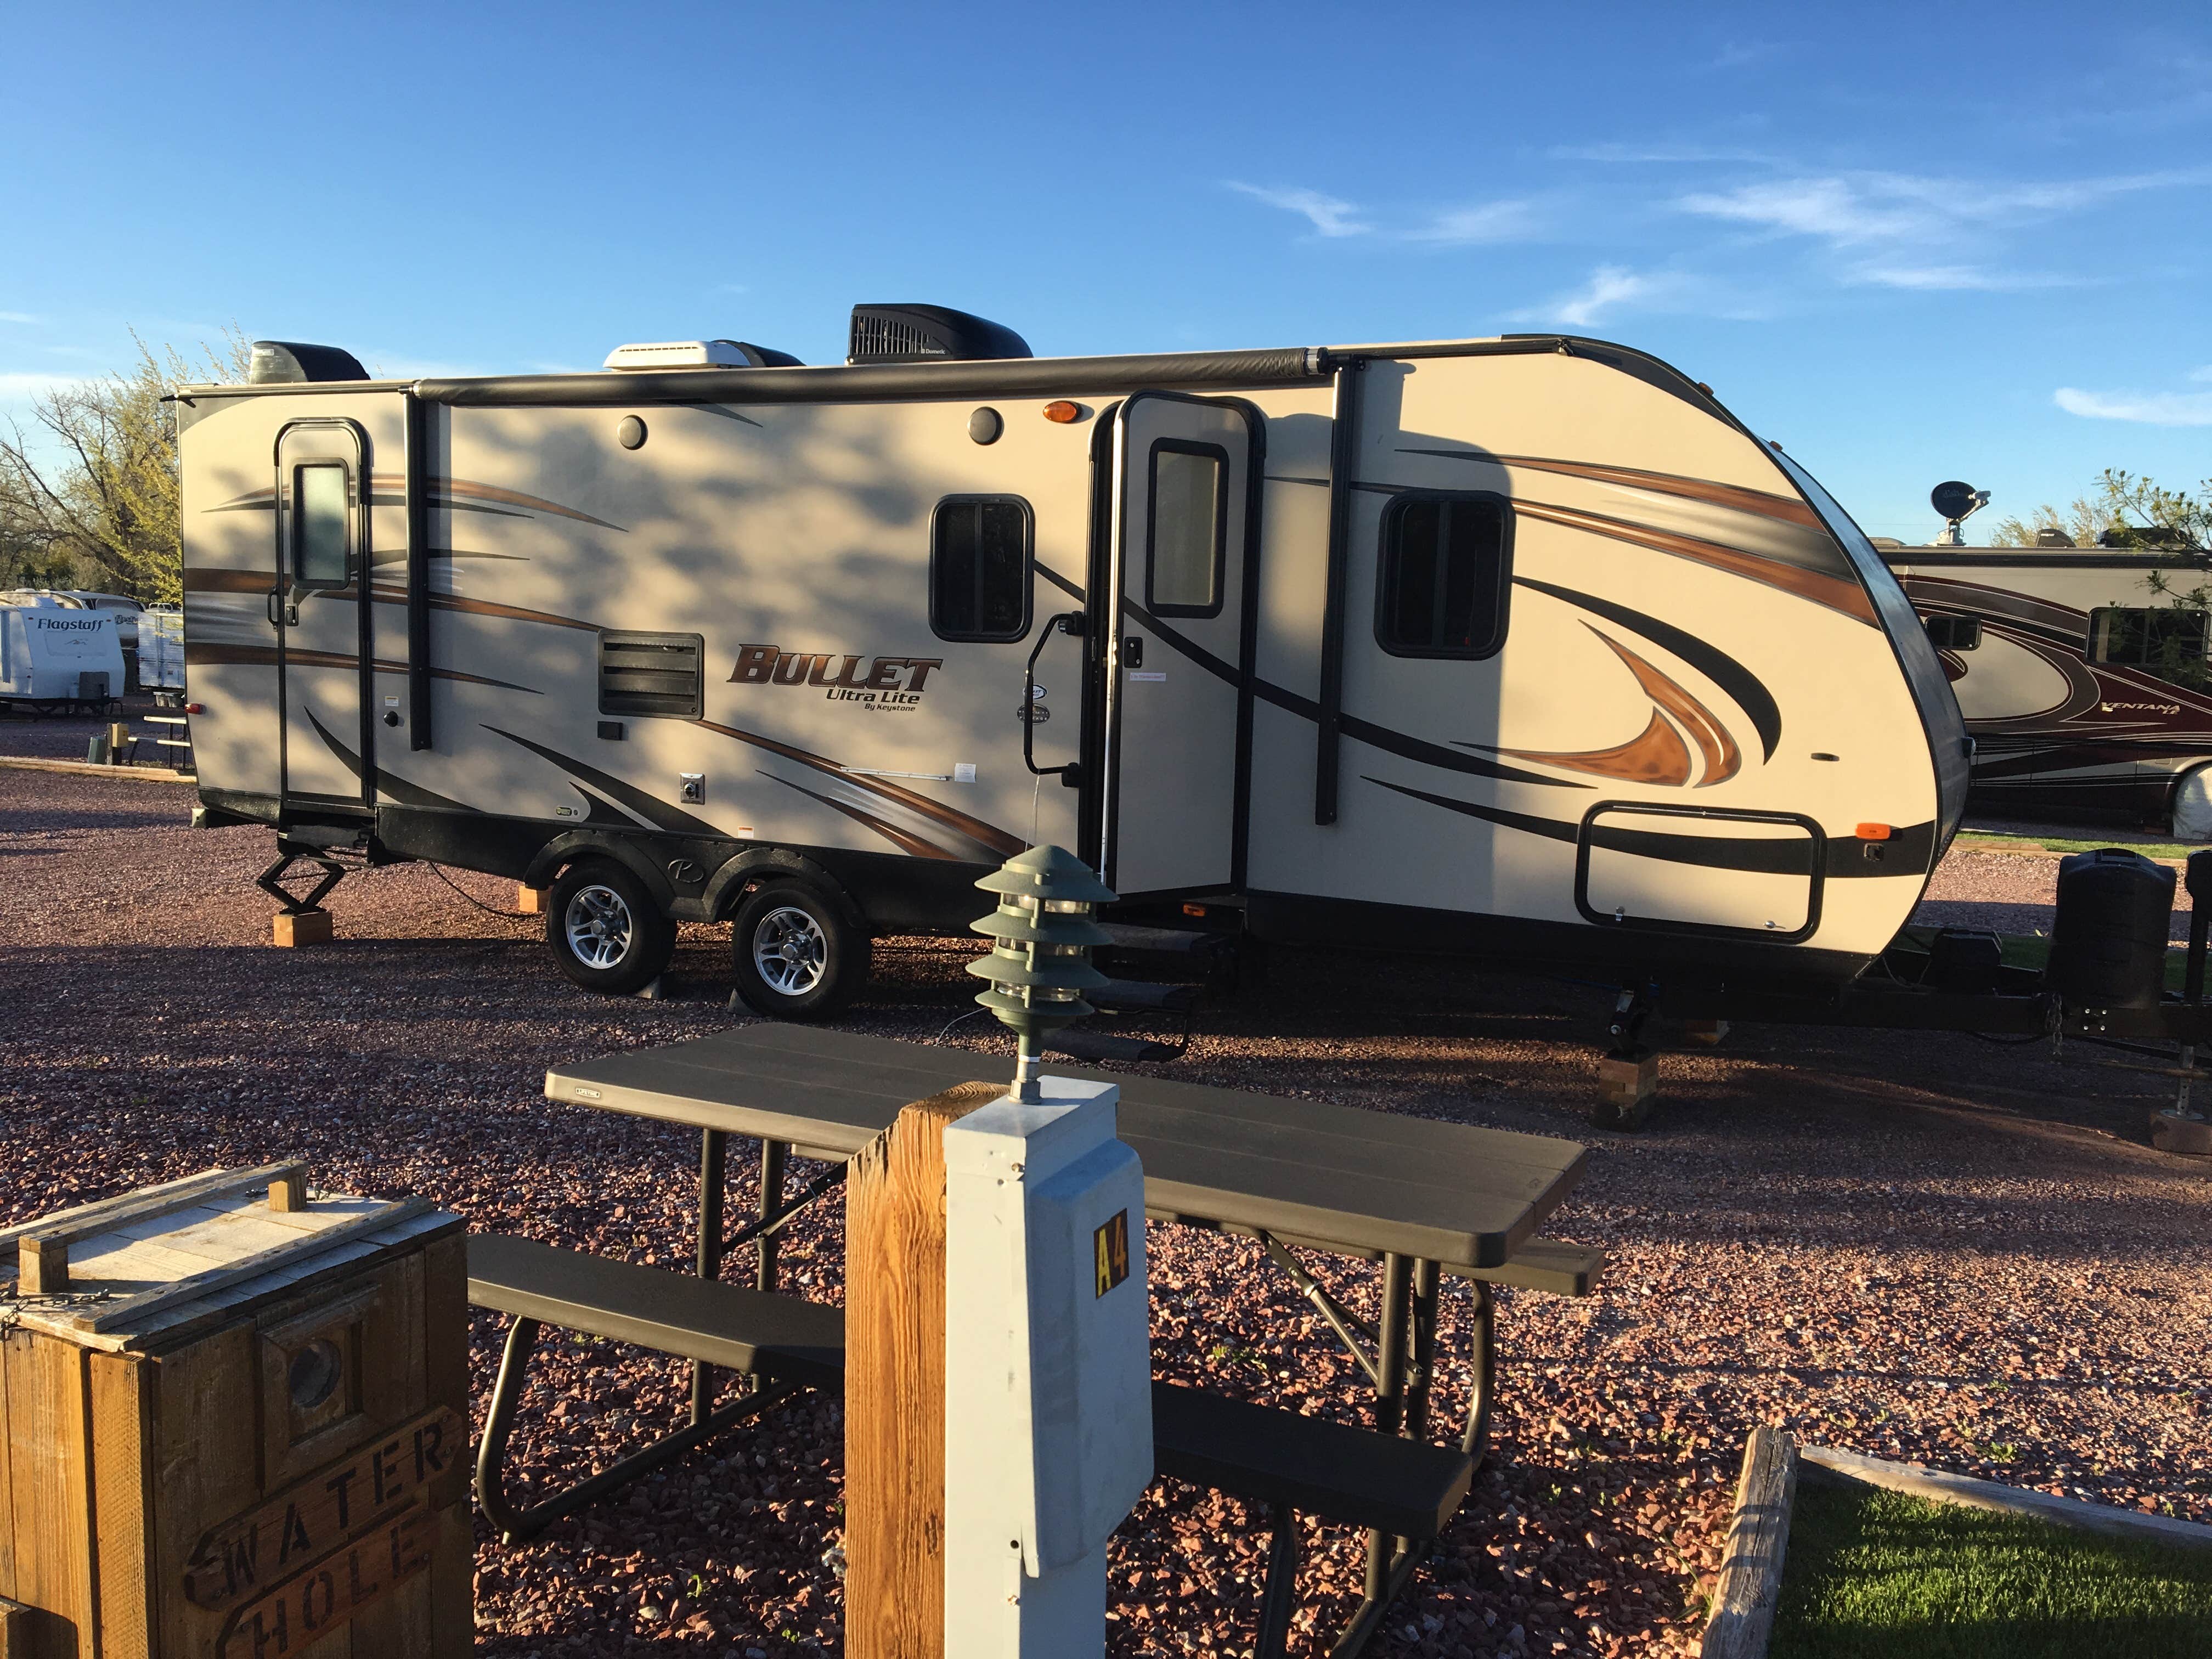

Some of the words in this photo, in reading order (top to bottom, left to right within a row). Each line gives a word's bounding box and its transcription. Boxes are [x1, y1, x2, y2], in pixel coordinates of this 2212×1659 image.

[37, 618, 104, 631] Flagstaff
[726, 644, 944, 692] BULLET
[826, 689, 876, 702] Ultra
[881, 691, 921, 704] Lite
[865, 703, 876, 711] By
[877, 703, 916, 712] Keystone
[2101, 702, 2180, 712] VENTANA
[1098, 1216, 1127, 1297] A4
[221, 1426, 443, 1595] WATER
[253, 1517, 422, 1659] HOLE
